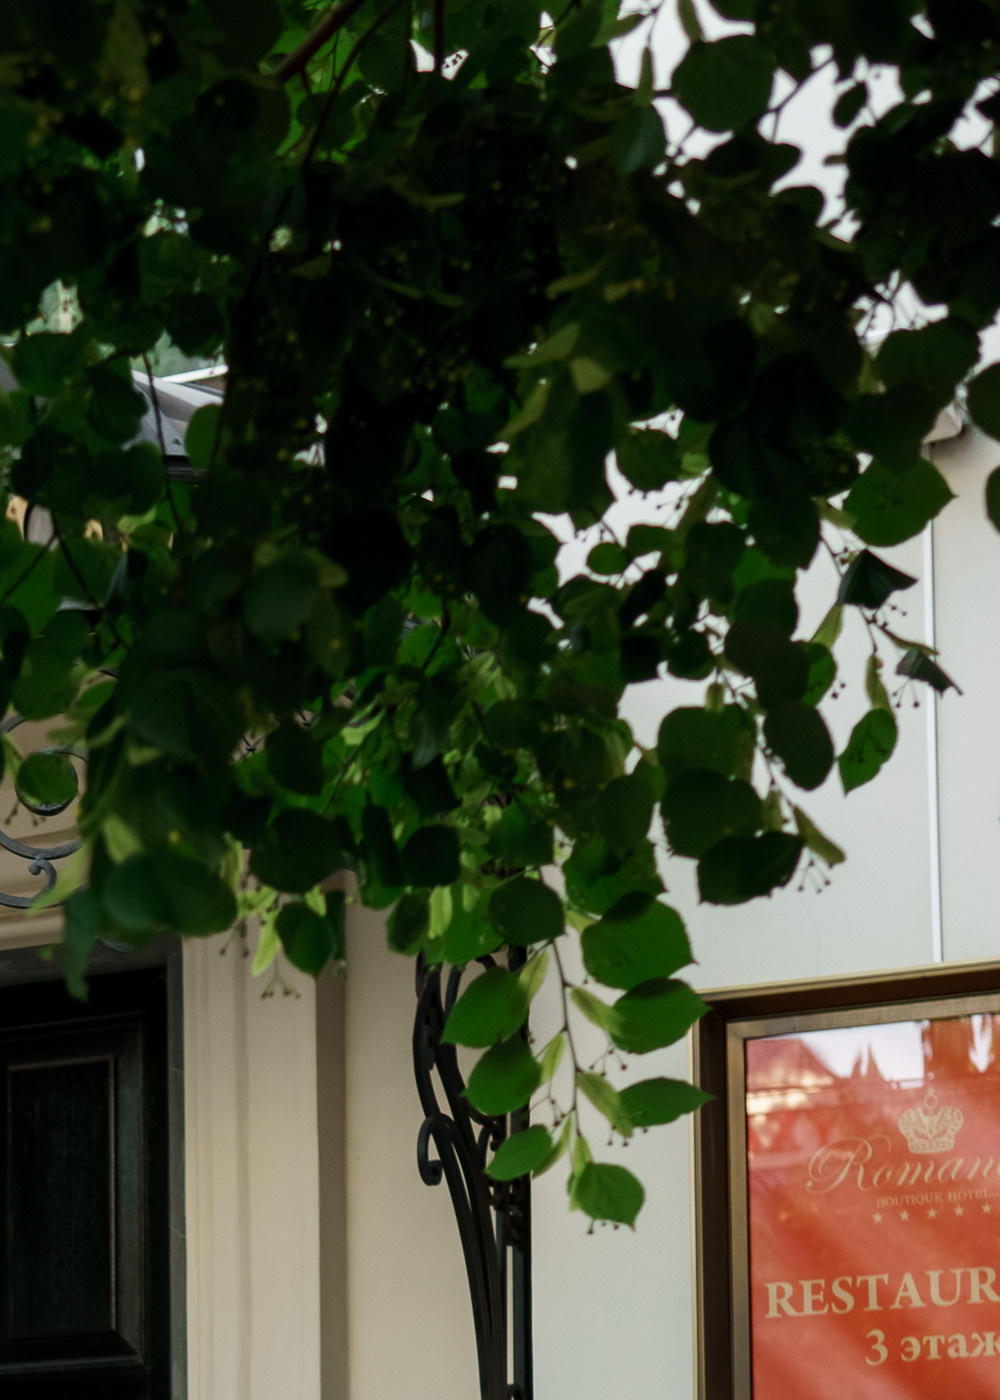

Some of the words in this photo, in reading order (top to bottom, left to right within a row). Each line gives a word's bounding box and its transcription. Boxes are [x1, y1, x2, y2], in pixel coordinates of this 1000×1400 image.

[805, 1134, 1000, 1196] Roman
[876, 1193, 944, 1209] BOUTIQUE
[947, 1187, 991, 1204] HOTEL
[764, 1265, 1000, 1319] RESTAUR
[865, 1328, 889, 1366] 3
